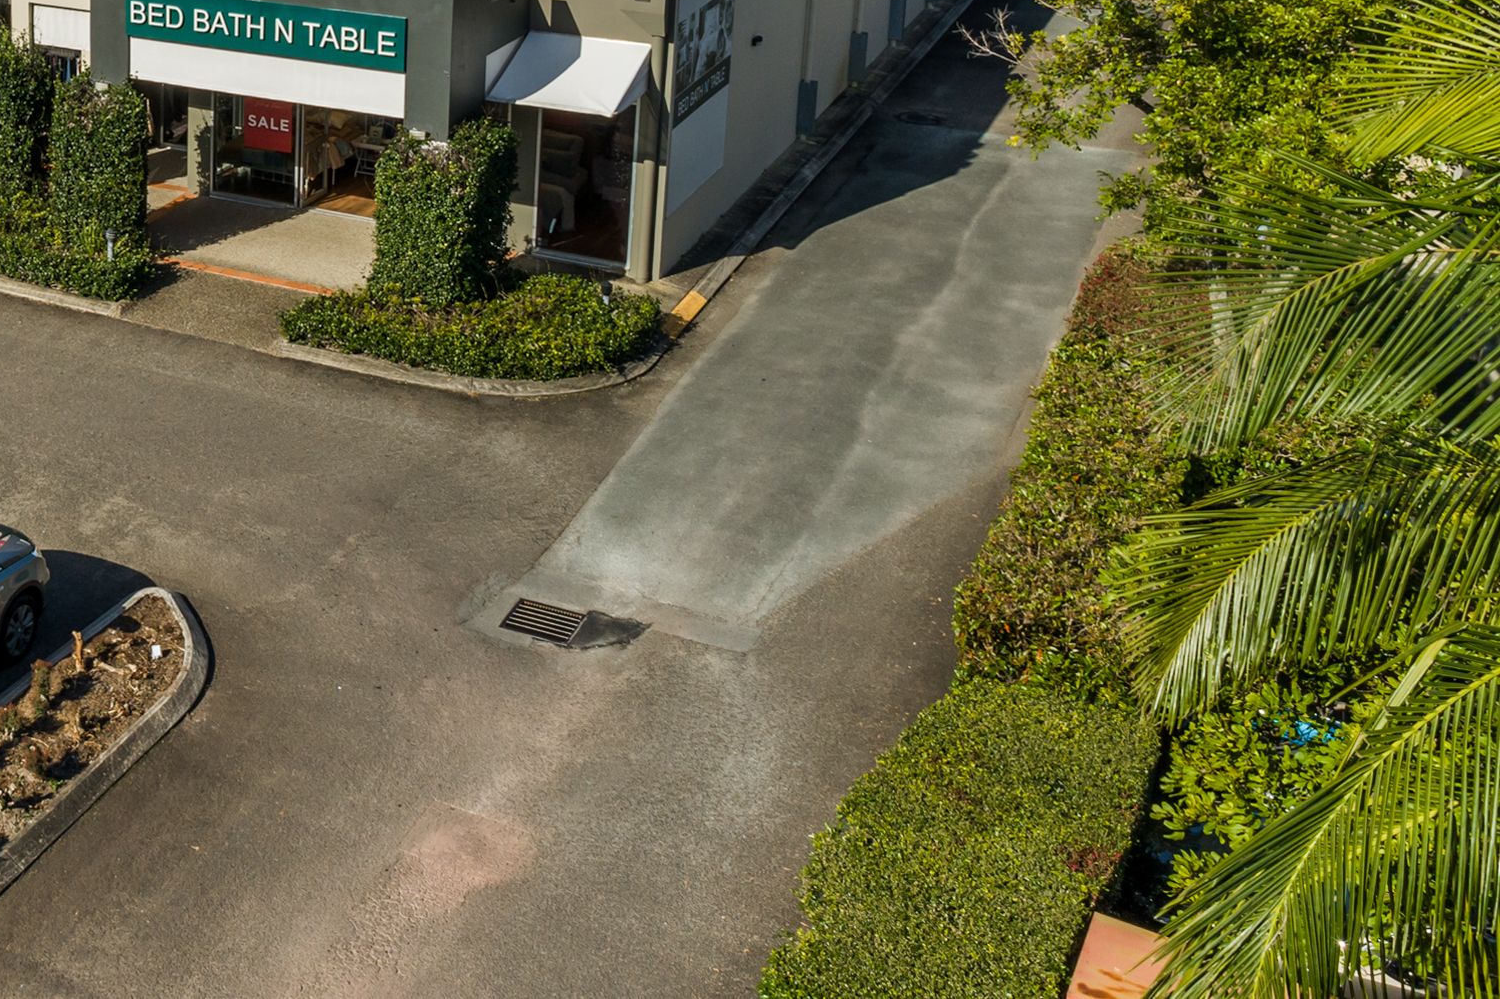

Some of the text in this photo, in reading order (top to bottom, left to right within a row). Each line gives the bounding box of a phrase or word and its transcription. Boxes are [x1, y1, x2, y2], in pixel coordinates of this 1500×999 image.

[129, 0, 396, 57] BED BATH N TABLE
[247, 114, 290, 133] SALE
